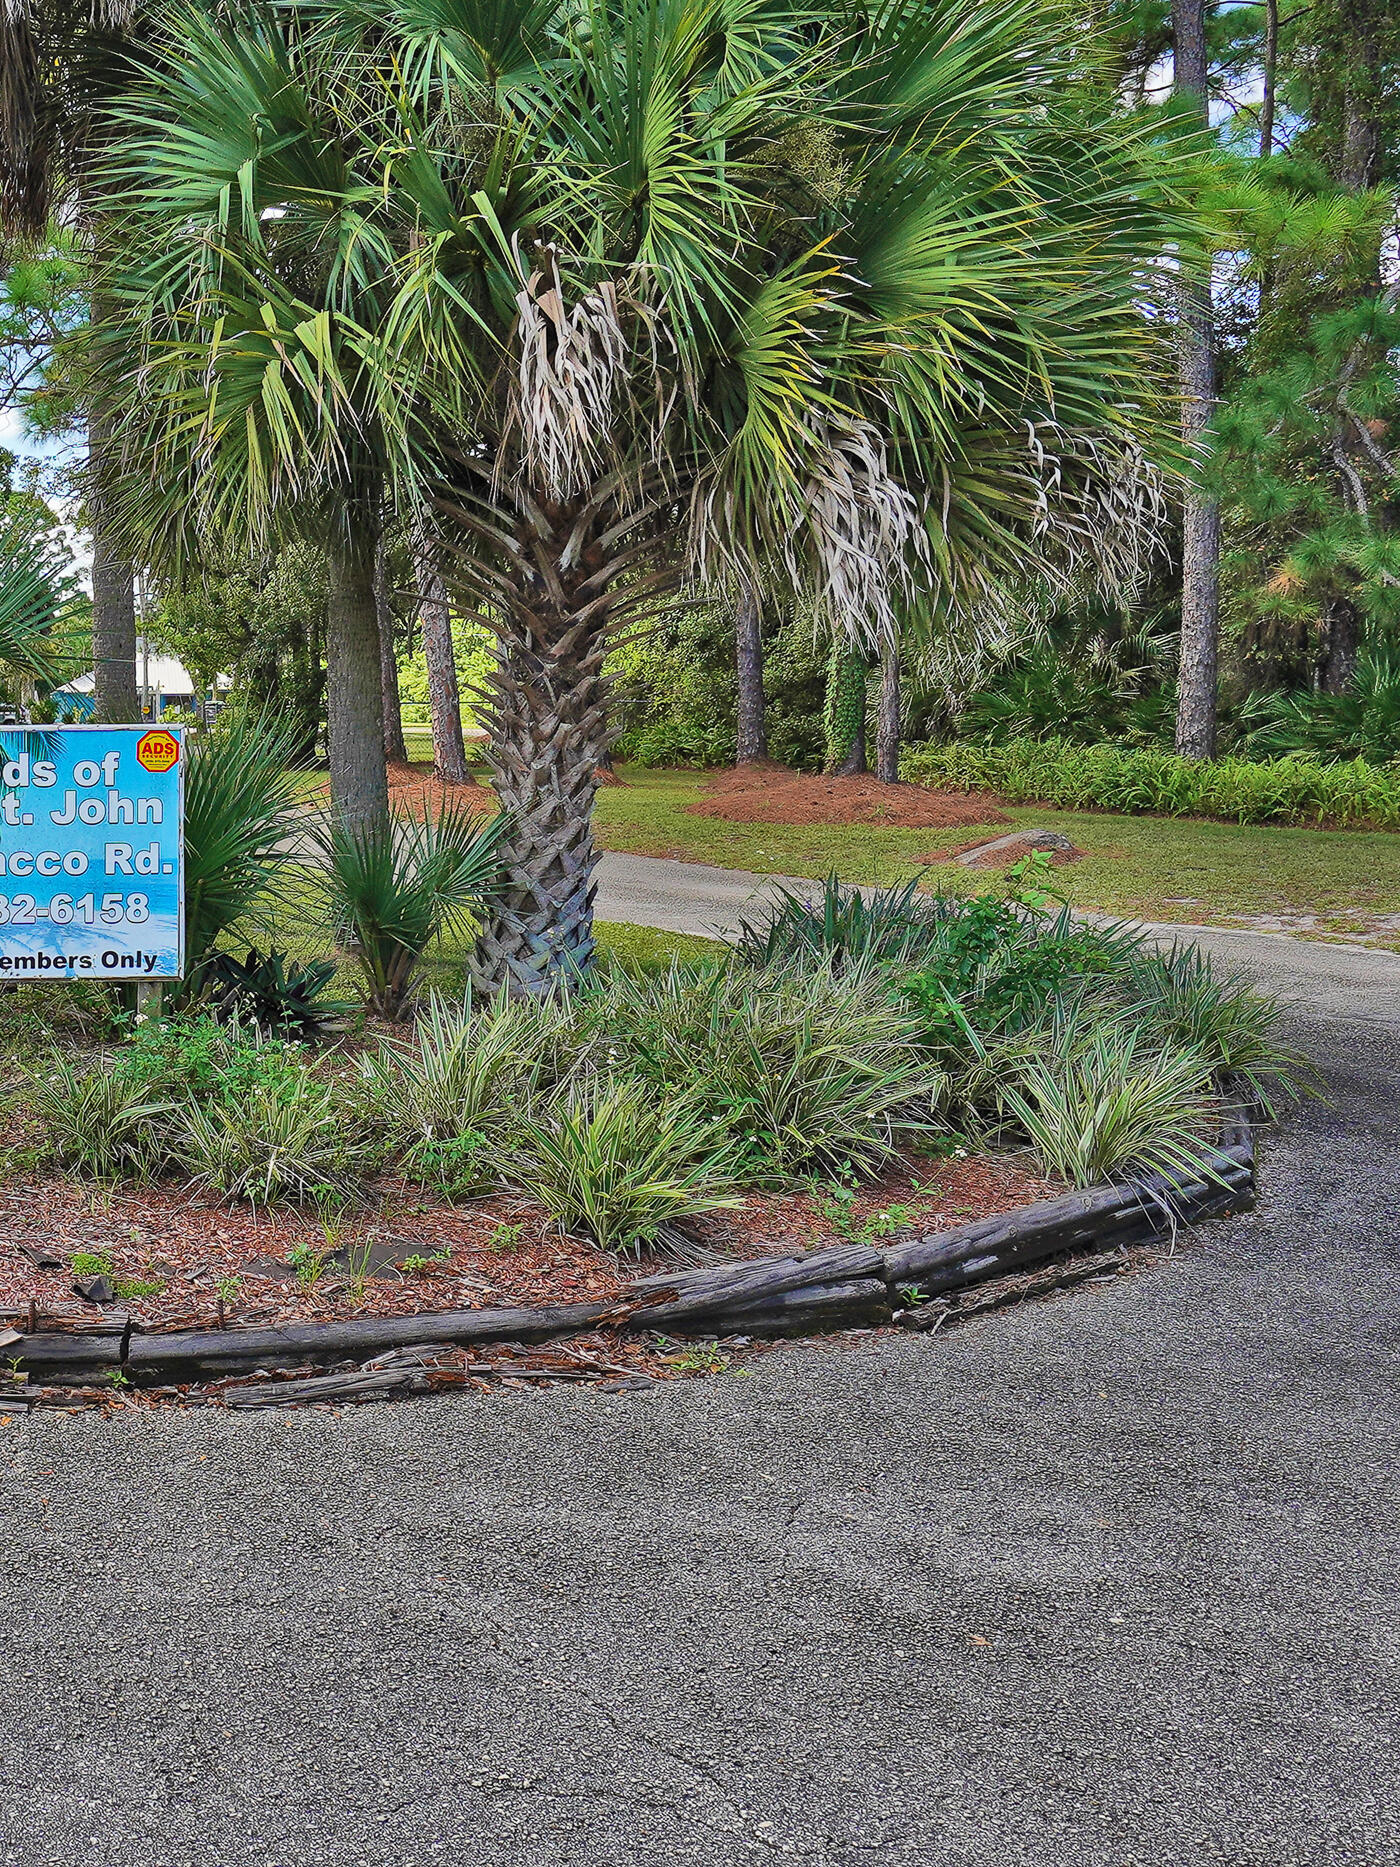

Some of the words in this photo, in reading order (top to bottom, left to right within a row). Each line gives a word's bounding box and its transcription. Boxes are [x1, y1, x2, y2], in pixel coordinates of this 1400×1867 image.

[142, 742, 174, 754] ADS
[73, 751, 120, 786] of
[50, 789, 163, 826] John
[104, 841, 174, 875] Rd.
[101, 950, 158, 973] Only
